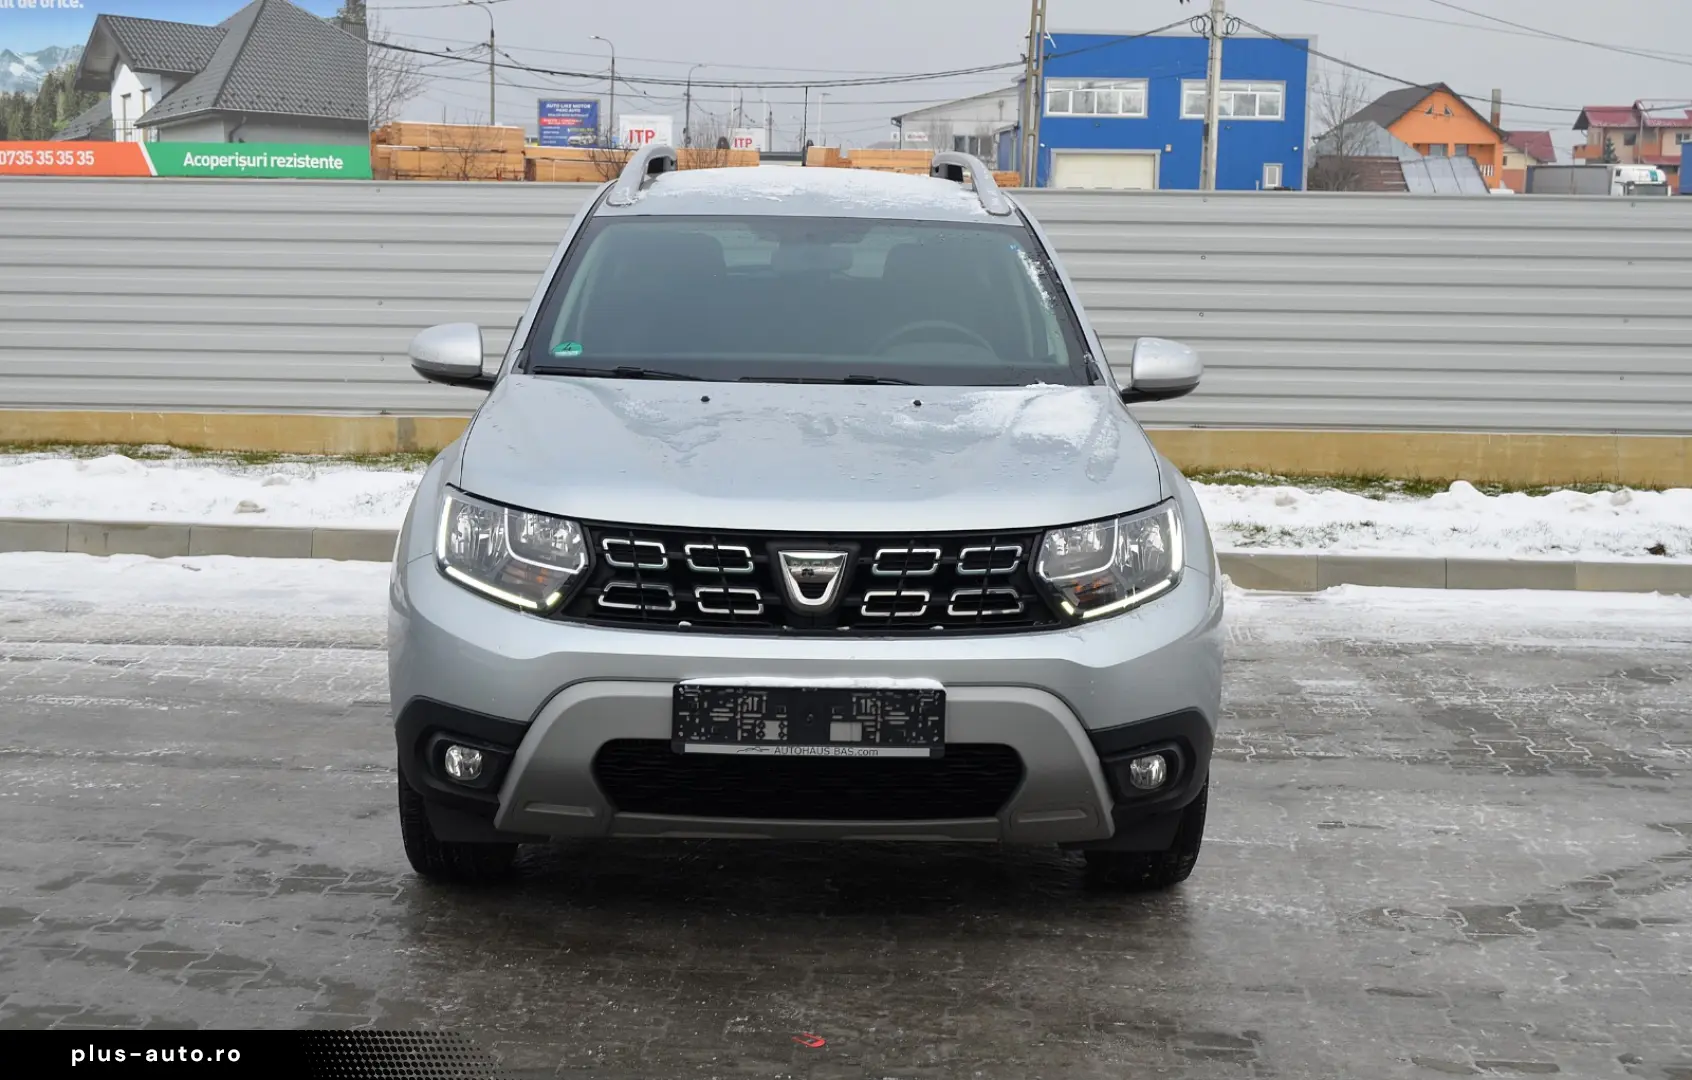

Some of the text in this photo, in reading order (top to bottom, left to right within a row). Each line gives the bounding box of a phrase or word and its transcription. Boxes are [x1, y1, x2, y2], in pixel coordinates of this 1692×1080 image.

[40, 0, 84, 8] orice.
[629, 129, 655, 144] ITP
[734, 137, 752, 148] ITP
[0, 150, 95, 165] 0735 35 35 35
[183, 152, 344, 171] Acoperișuri rezistente
[774, 746, 879, 756] AUTOHAUS BAS.com
